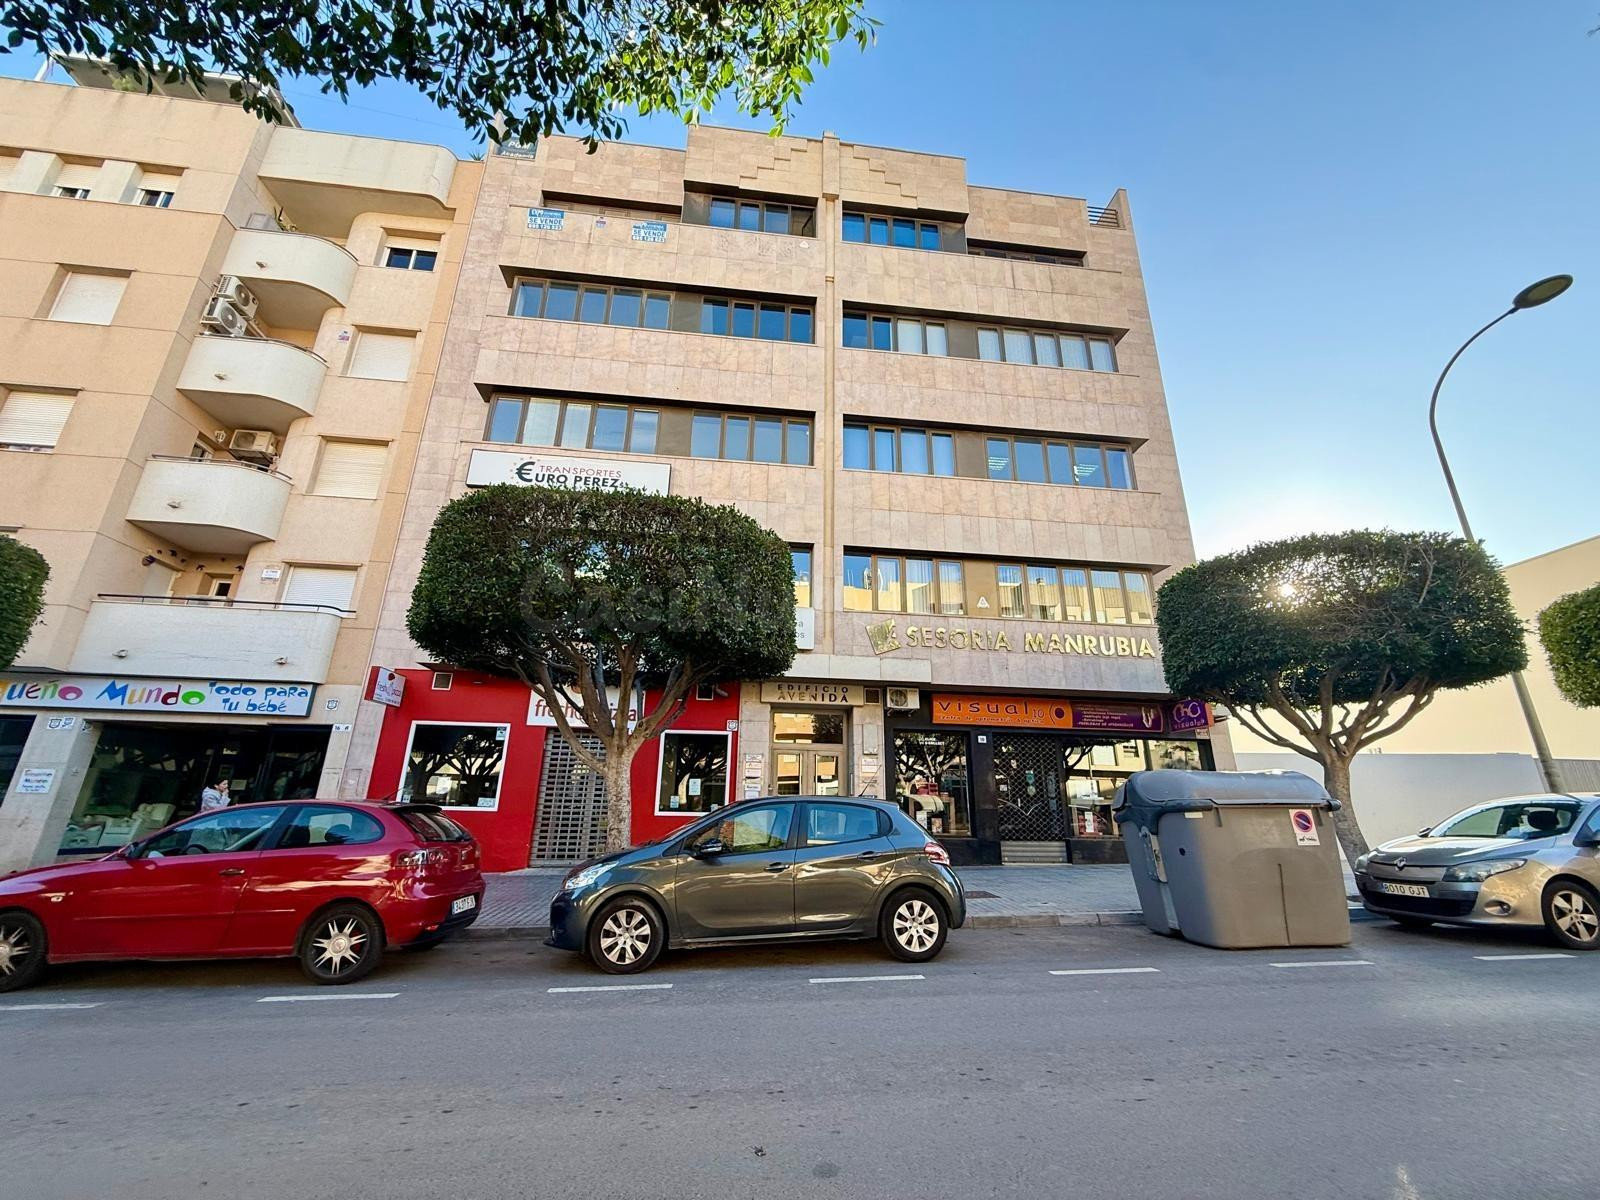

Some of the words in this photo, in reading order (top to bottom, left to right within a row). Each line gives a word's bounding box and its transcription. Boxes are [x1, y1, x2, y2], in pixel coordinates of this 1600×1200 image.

[540, 218, 563, 226] VENDE
[643, 230, 666, 238] VENDE
[540, 465, 622, 479] TRANSPORTES
[574, 475, 619, 489] PEREZ
[1024, 631, 1156, 658] MANRUBIA
[95, 679, 206, 706] Mundo
[777, 684, 849, 694] EDIFICIO
[777, 692, 849, 703] AVENIDA
[938, 700, 1029, 715] visual
[1384, 883, 1405, 894] 8010
[1408, 886, 1426, 897] GJT
